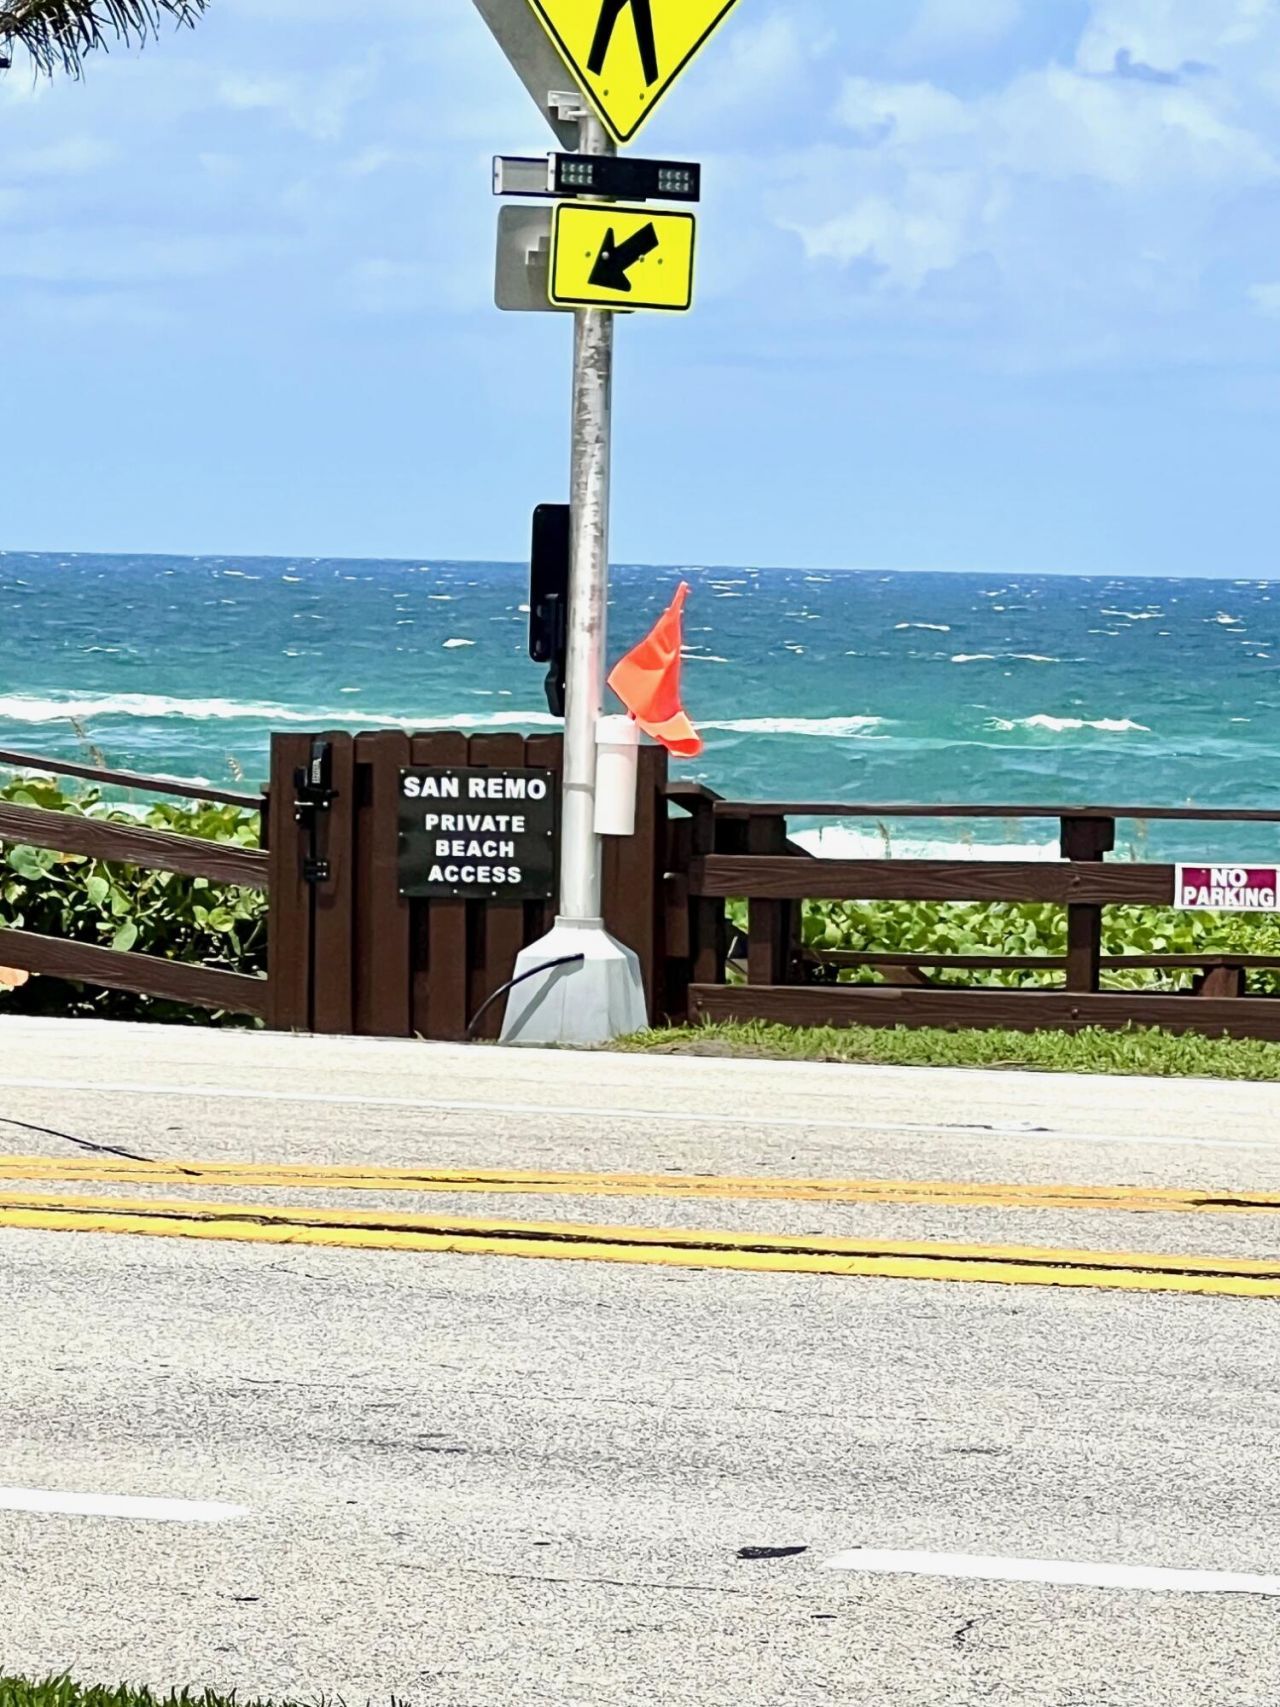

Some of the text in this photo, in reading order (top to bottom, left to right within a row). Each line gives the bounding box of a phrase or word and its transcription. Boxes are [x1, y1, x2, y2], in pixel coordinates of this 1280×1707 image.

[403, 776, 547, 799] SAN REMO
[425, 814, 525, 832] PRIVATE
[435, 839, 515, 857] BEACH
[427, 865, 522, 883] ACCESS
[1210, 868, 1248, 887] NO
[1183, 886, 1275, 907] PARKING
